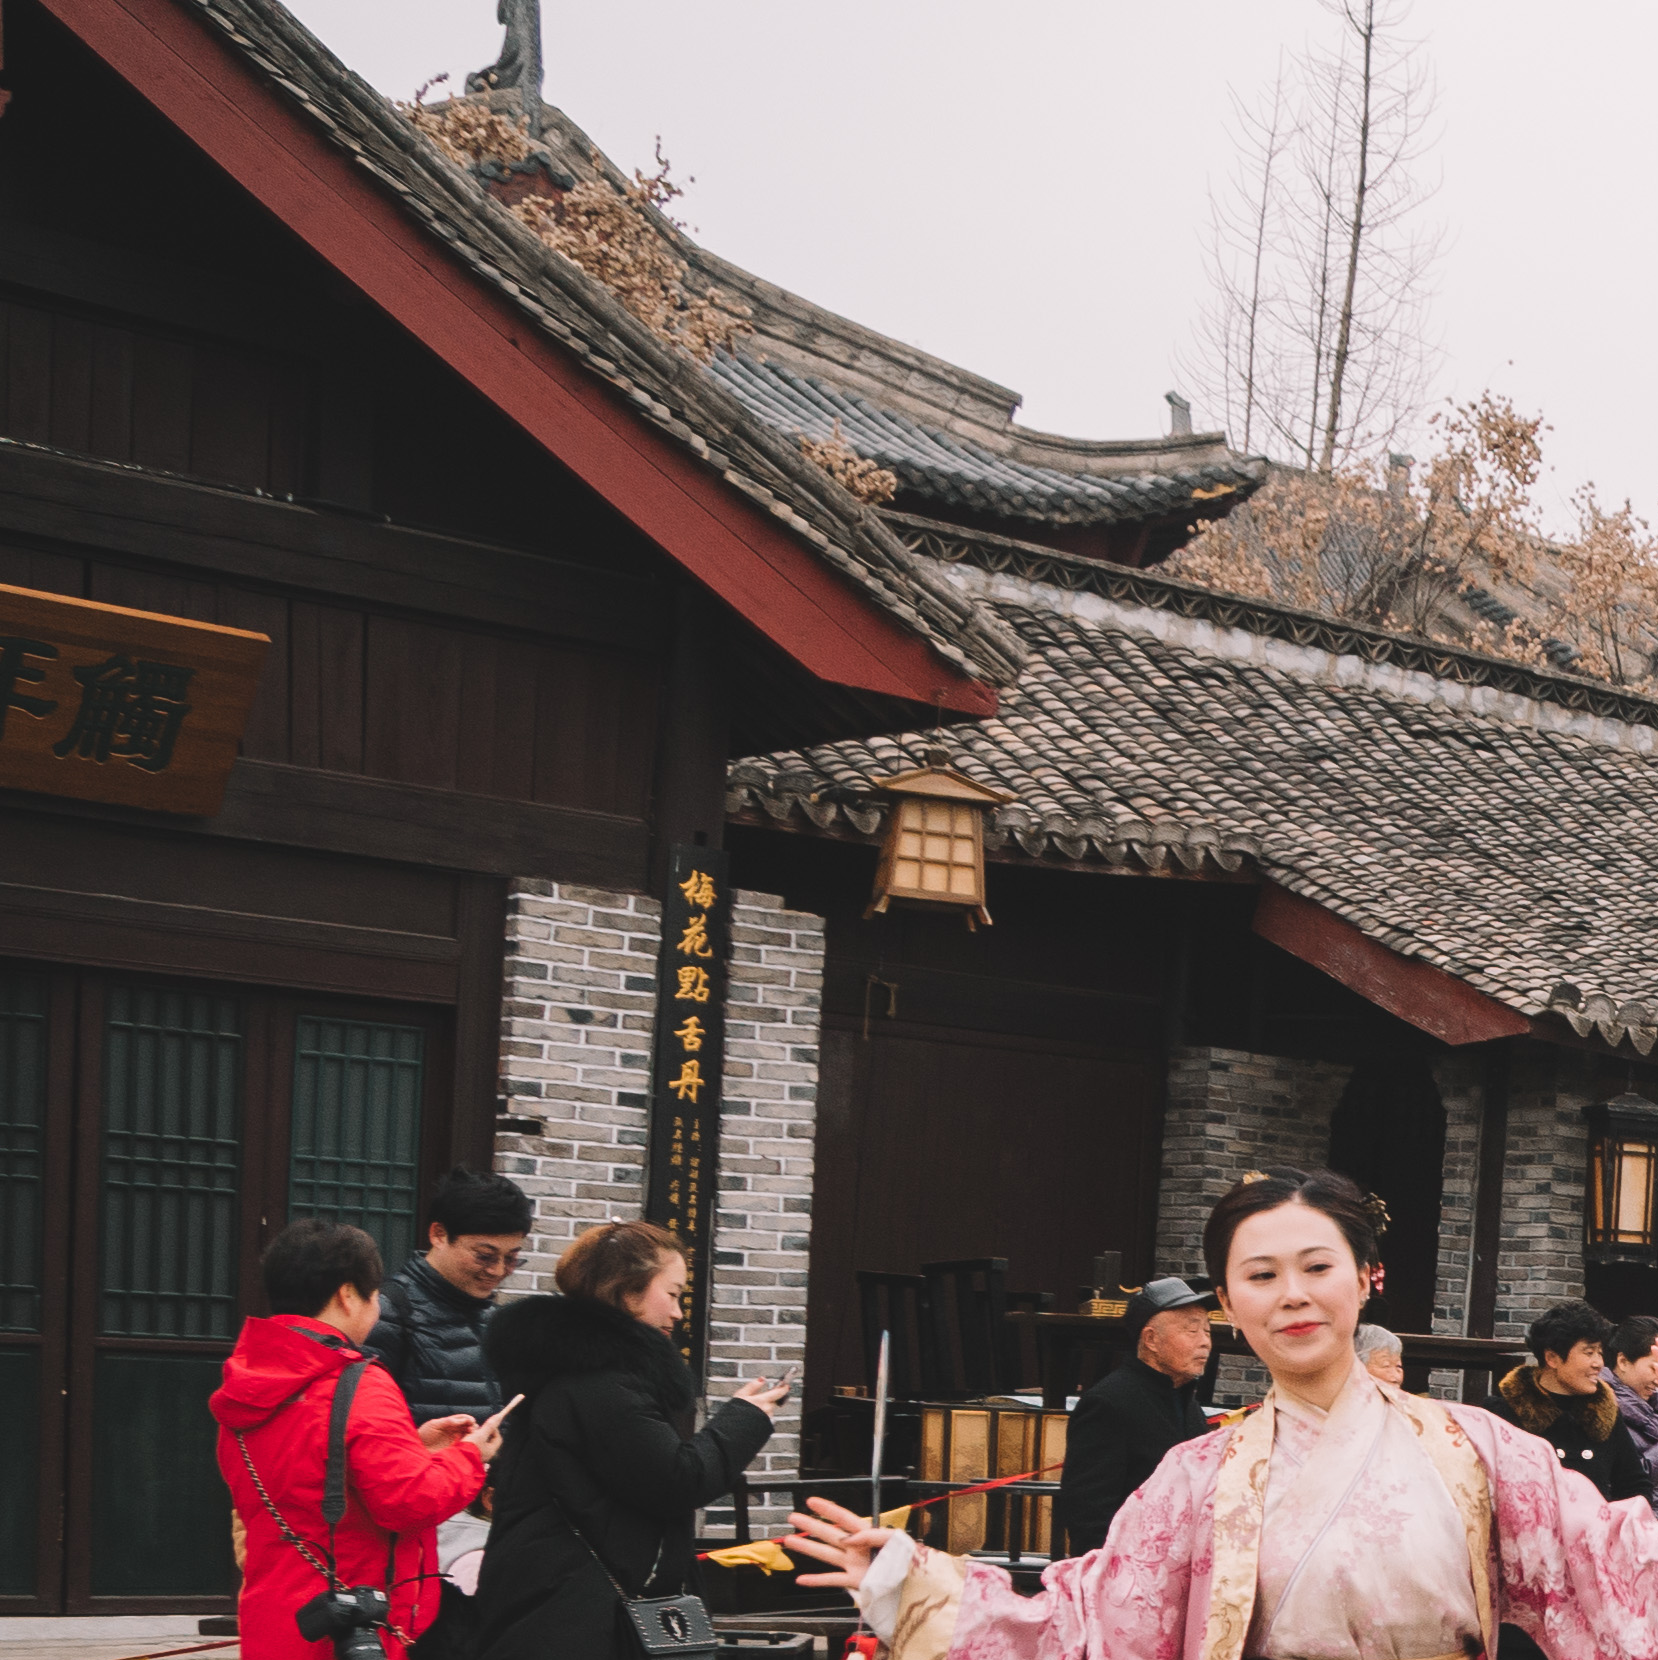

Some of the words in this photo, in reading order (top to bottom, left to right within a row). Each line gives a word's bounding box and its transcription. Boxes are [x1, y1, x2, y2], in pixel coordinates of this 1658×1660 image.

[669, 870, 718, 1103] 梅花點舌丹
